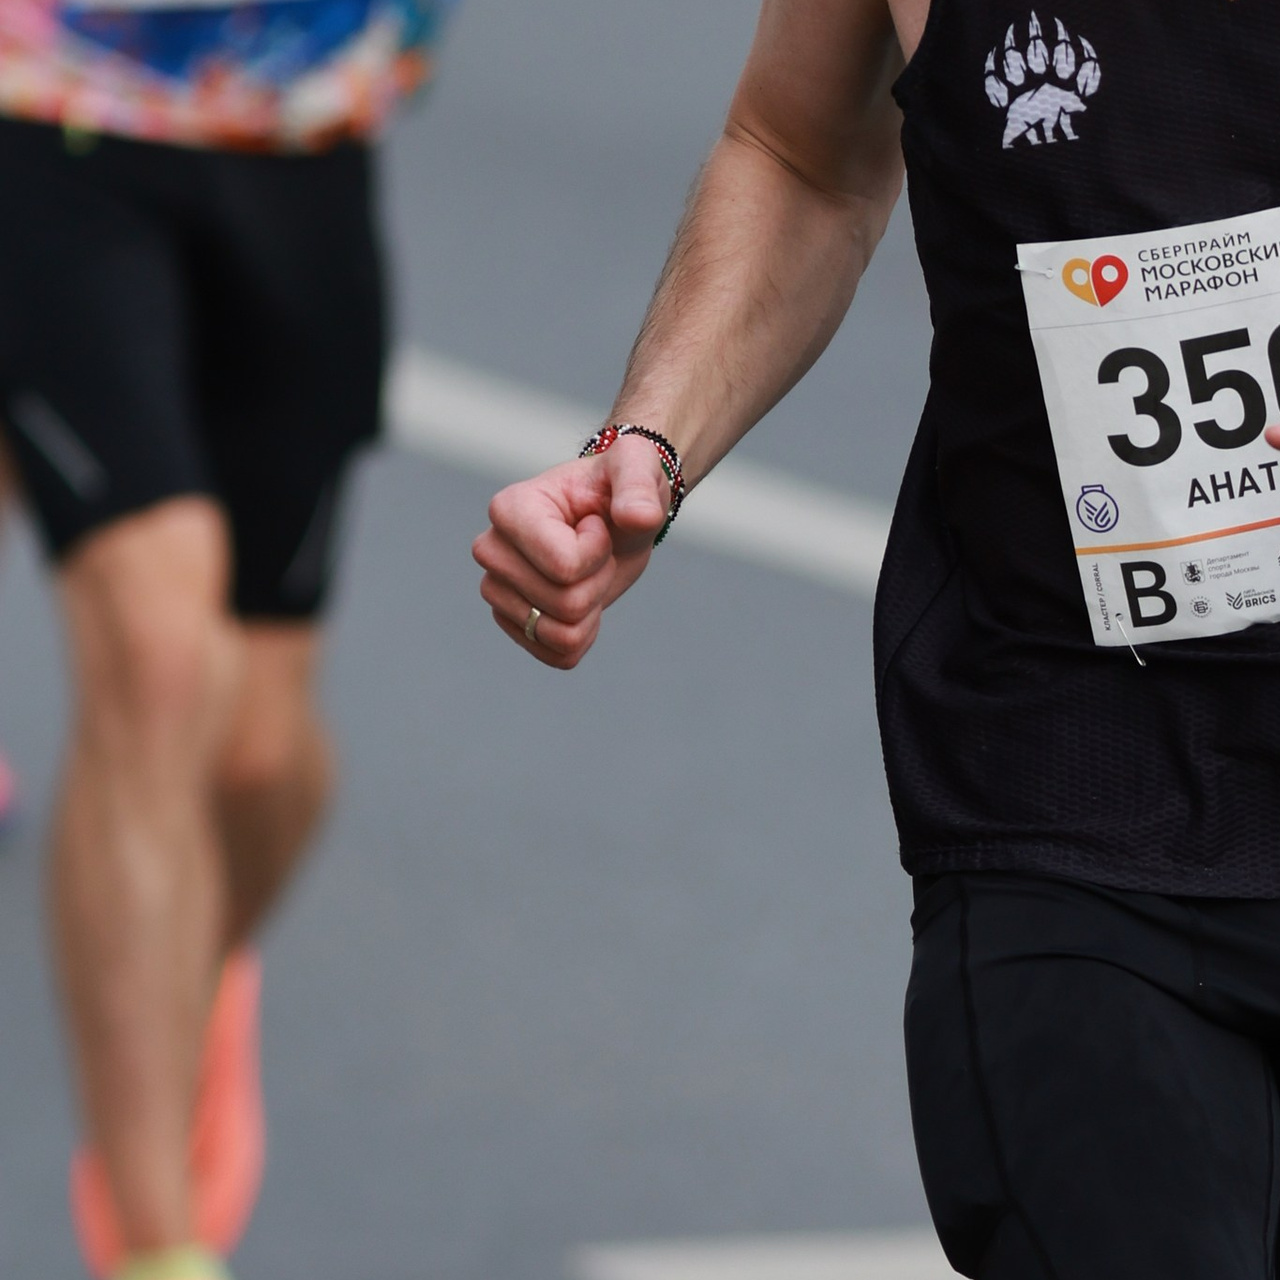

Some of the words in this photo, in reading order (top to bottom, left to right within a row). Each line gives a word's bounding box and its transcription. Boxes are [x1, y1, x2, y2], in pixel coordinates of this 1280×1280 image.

[1137, 231, 1252, 263] СБЕРПРАЙМ
[1144, 267, 1259, 303] МАРАФОН
[1206, 551, 1249, 566] Департамент
[1092, 562, 1104, 592] CORRAL
[1098, 597, 1111, 632] КЛАСТЕР
[1245, 594, 1277, 608] BRICS
